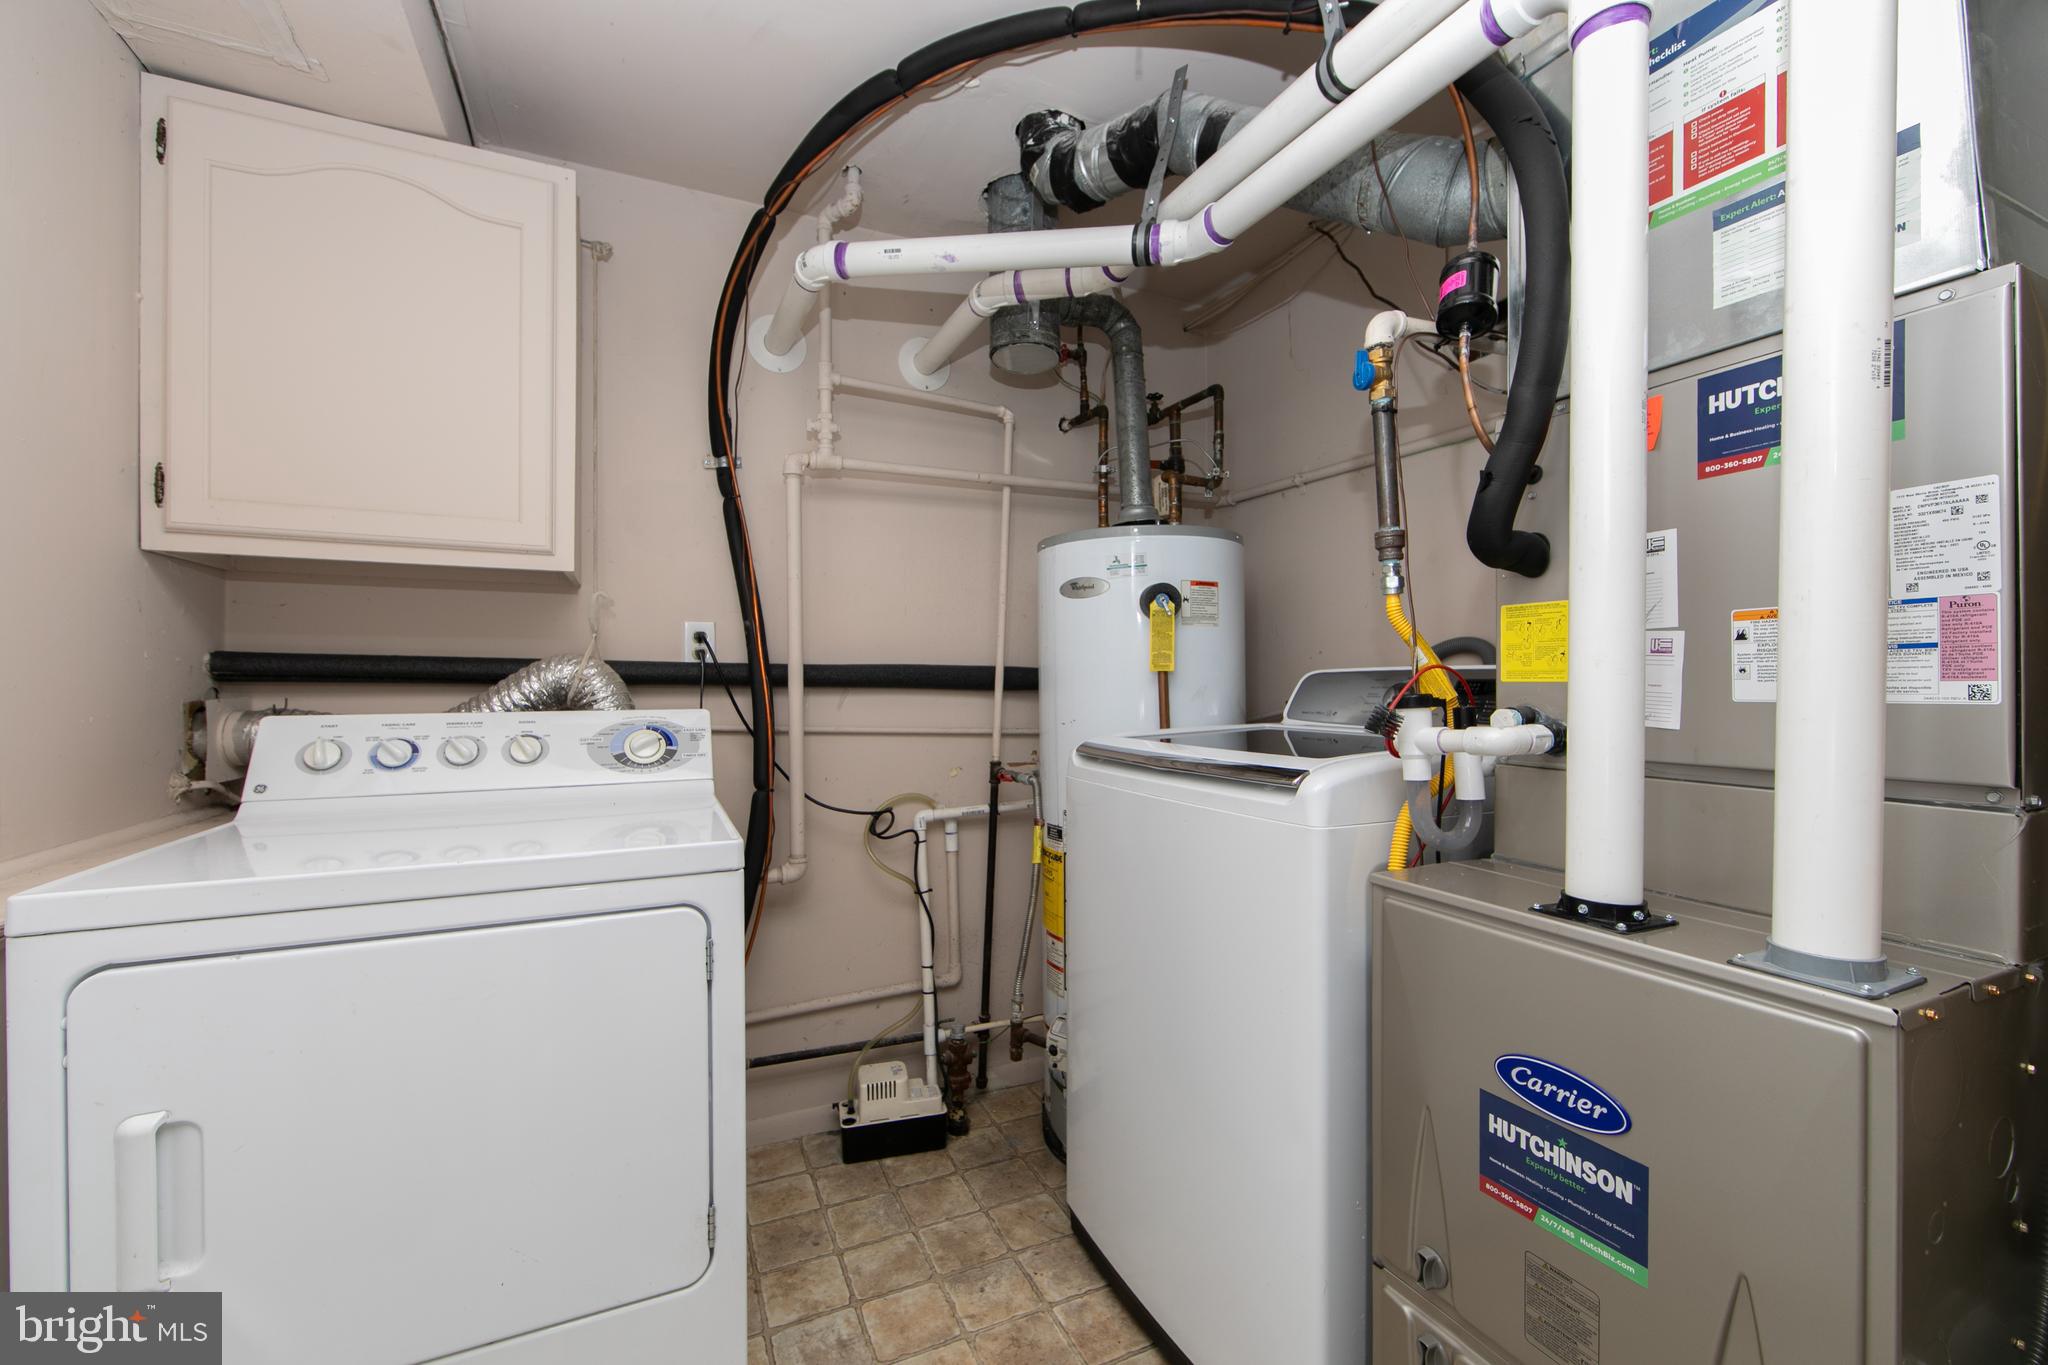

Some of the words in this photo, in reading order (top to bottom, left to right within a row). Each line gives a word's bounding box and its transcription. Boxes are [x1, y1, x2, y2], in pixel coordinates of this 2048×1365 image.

[1649, 40, 1686, 66] hecklist
[1720, 206, 1749, 222] Expert
[1751, 196, 1776, 210] Alert:
[1754, 423, 1775, 432] Heating
[1705, 455, 1763, 473] 800-360-5807
[1511, 1067, 1608, 1119] Carrier
[1488, 1113, 1633, 1205] HUTCHINSON
[1526, 1156, 1558, 1180] Expertly
[1559, 1174, 1586, 1194] better.
[1485, 1183, 1533, 1214] 800-360-5807
[1540, 1214, 1575, 1239] 24/7/365
[1580, 1237, 1635, 1274] HutchBiz.com
